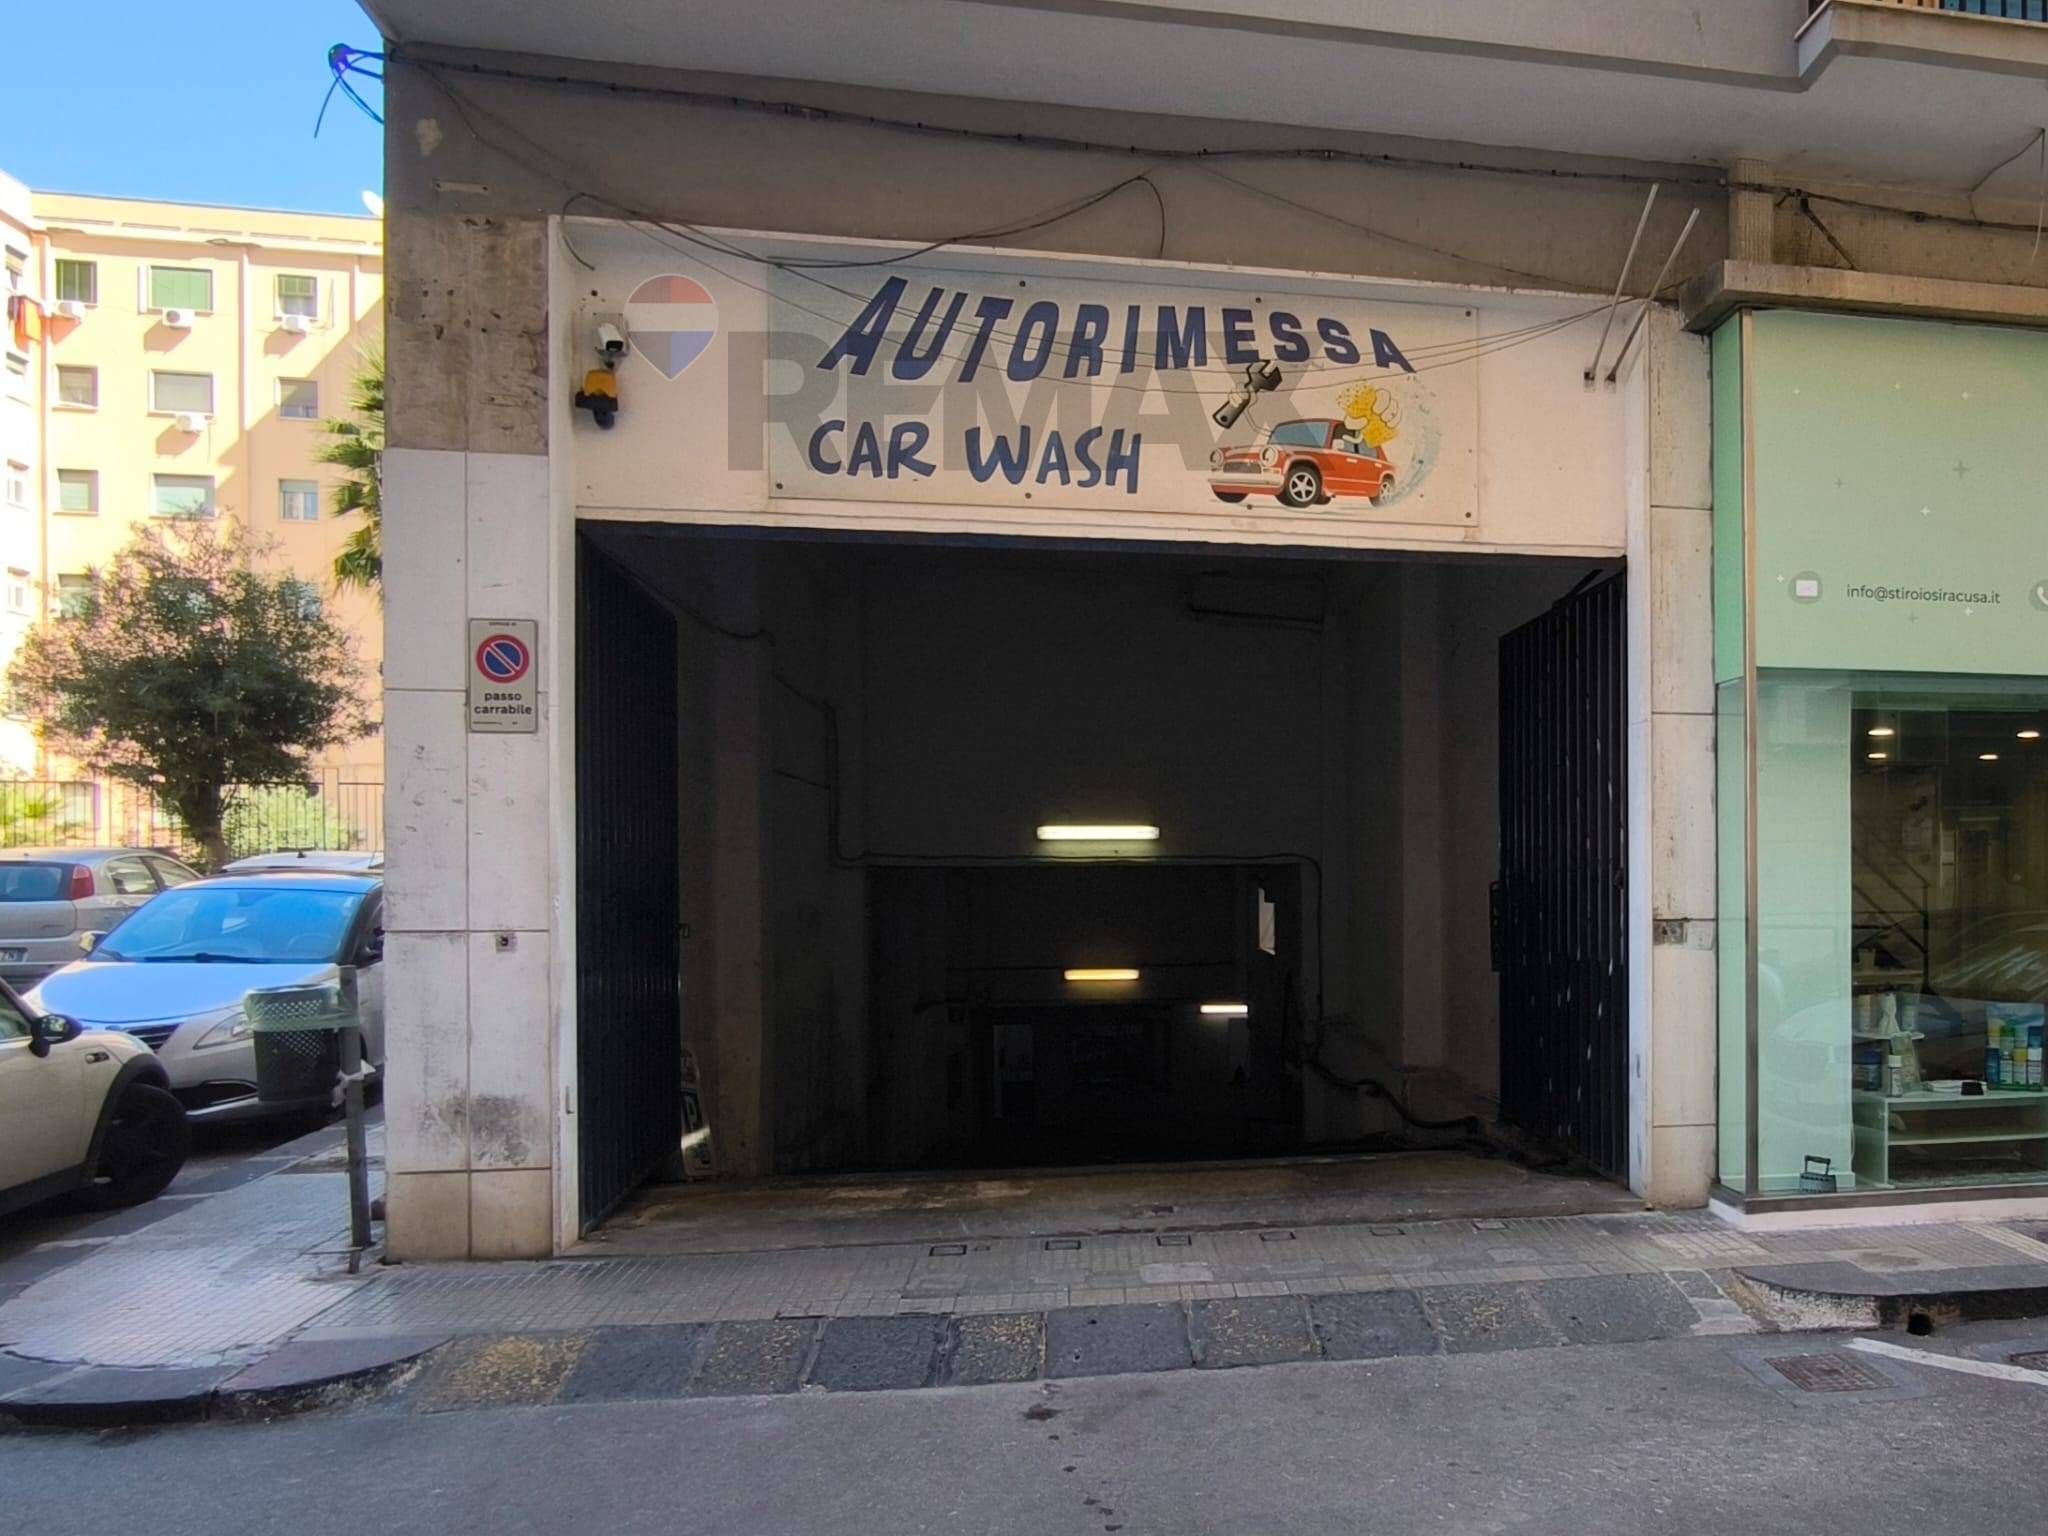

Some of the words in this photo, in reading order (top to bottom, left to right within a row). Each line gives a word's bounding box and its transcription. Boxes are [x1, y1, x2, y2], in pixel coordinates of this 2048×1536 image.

[817, 276, 1416, 382] AUTORIMESSA
[808, 419, 936, 479] CAR
[964, 425, 1140, 494] WASH
[1846, 584, 2000, 604] info@stiroiosiracusa.it
[484, 692, 522, 701] passo
[474, 704, 532, 714] carrabile
